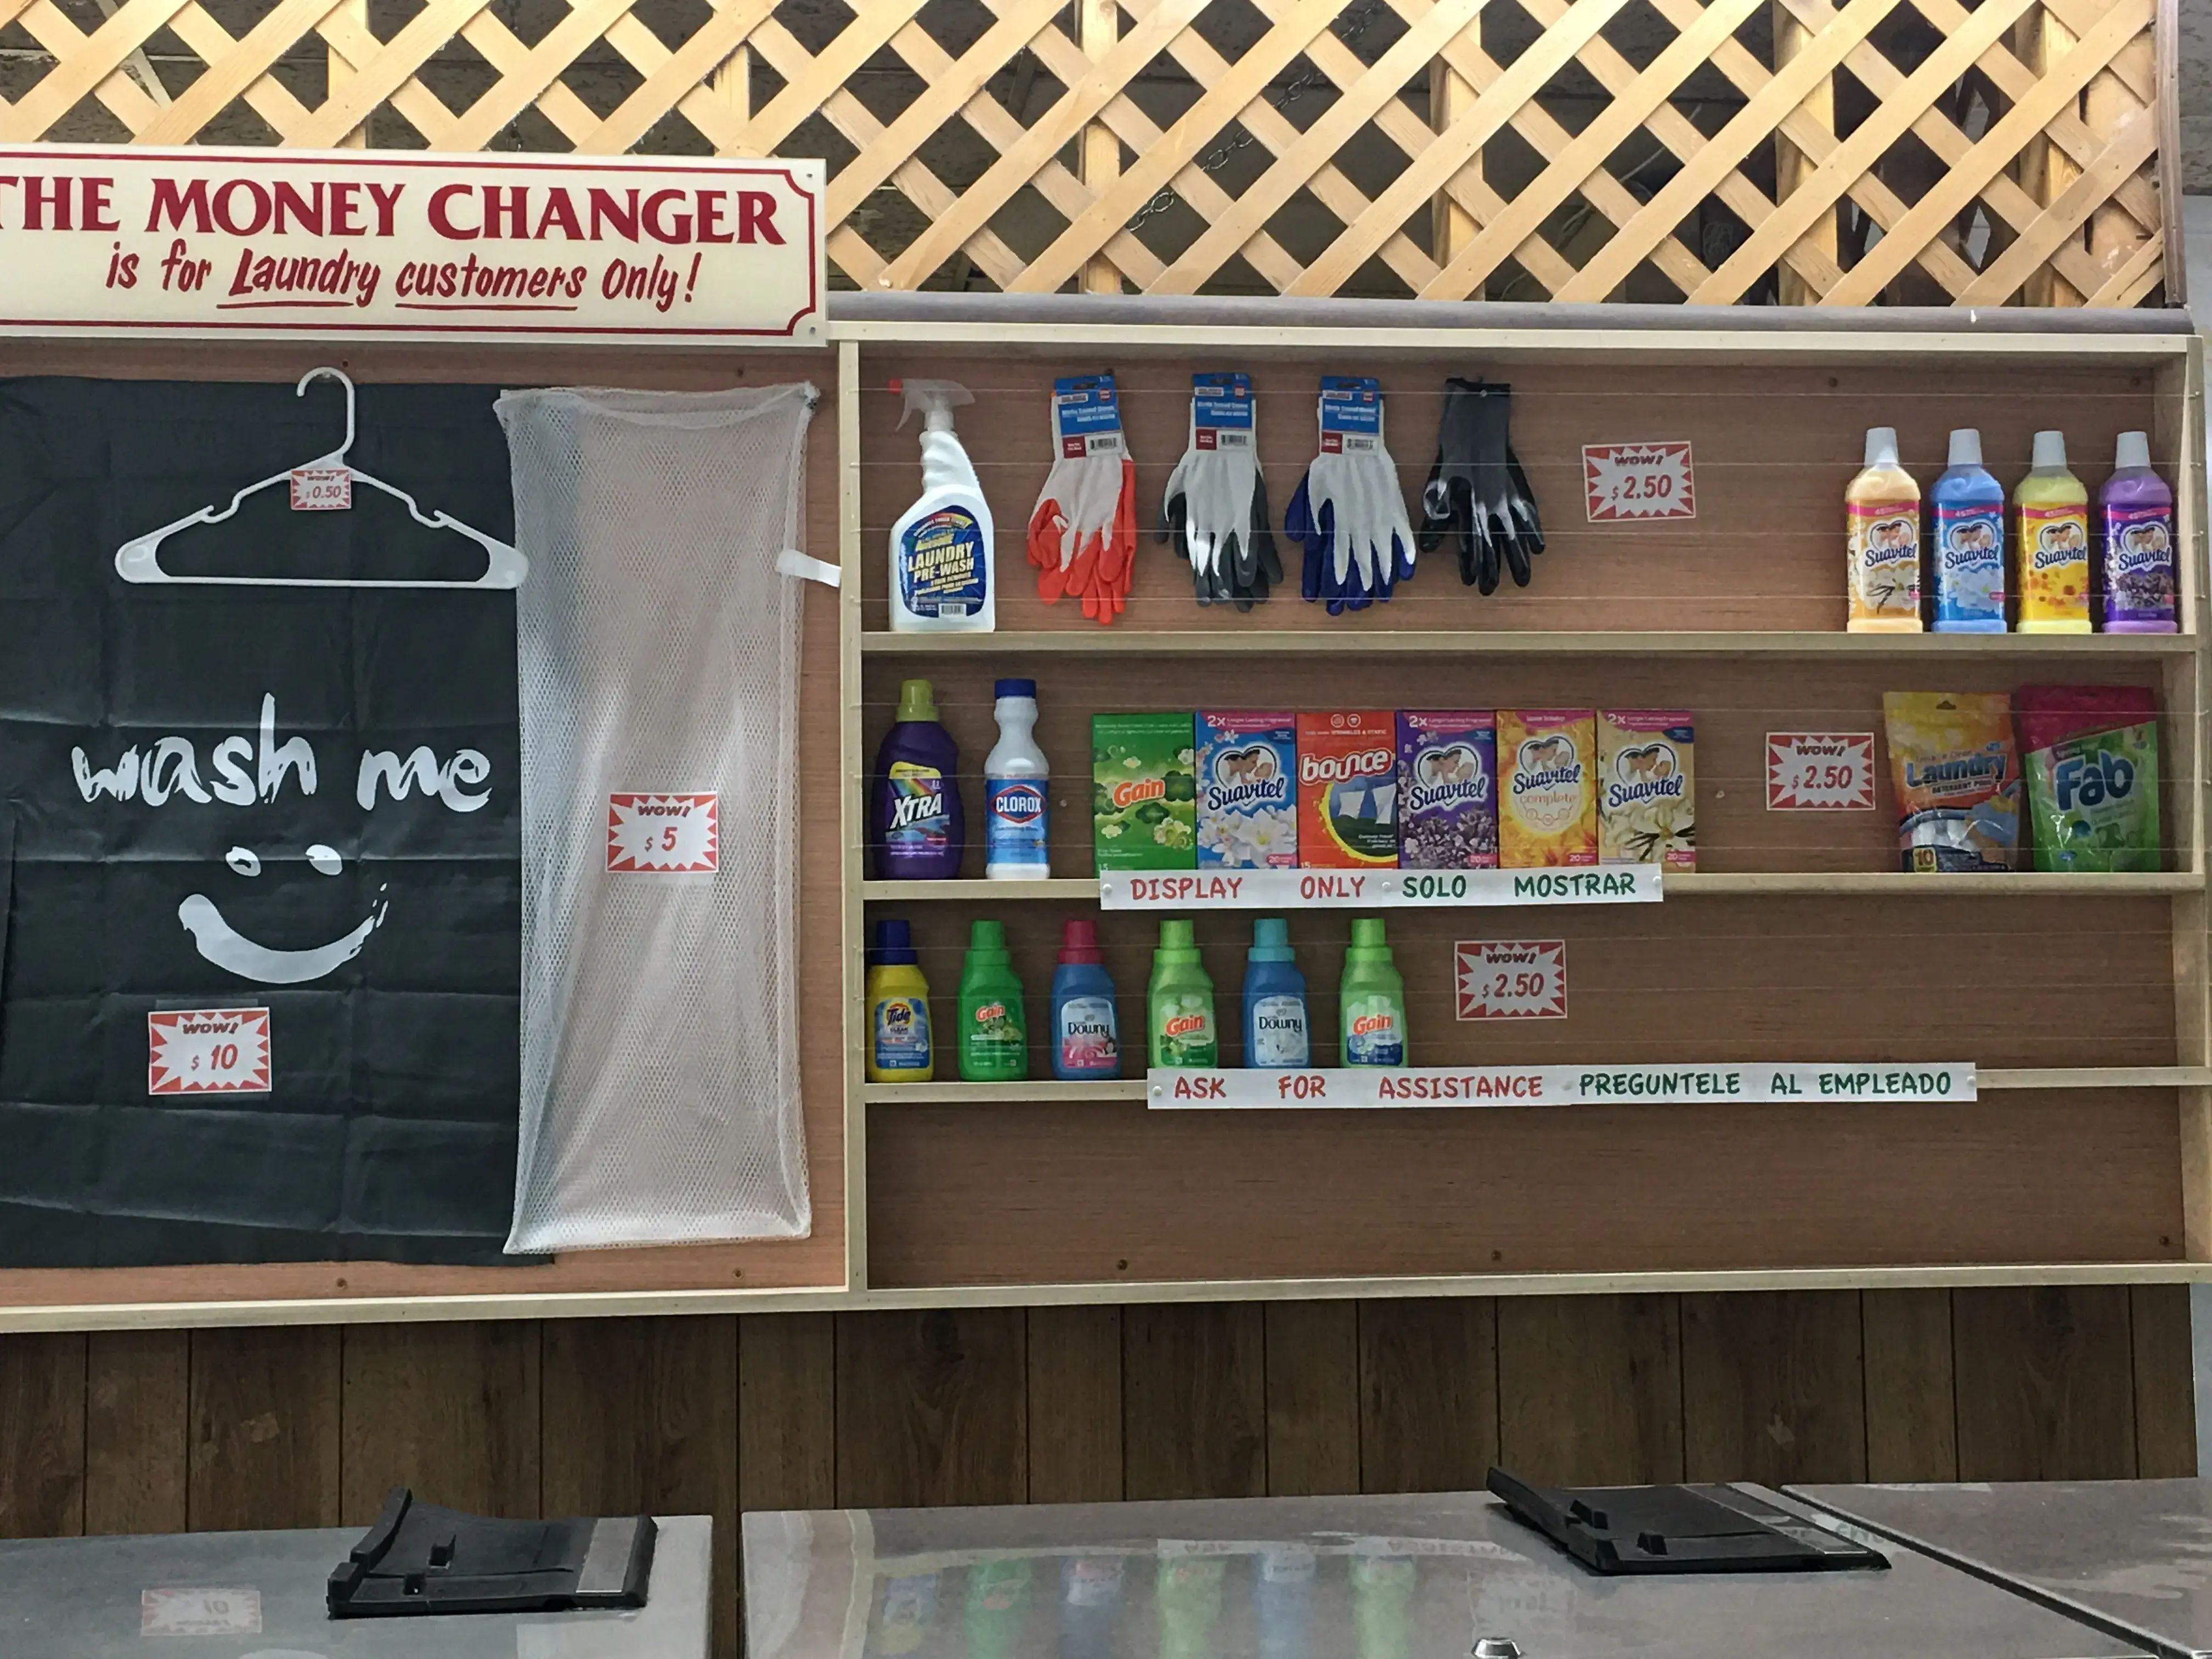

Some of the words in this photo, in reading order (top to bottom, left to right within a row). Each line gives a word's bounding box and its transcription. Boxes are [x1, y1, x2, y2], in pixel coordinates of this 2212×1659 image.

[144, 179, 406, 238] MONEY
[428, 184, 787, 245] CHANGER
[106, 241, 139, 289] is
[161, 239, 212, 292] for
[228, 249, 381, 308] Laundry
[396, 253, 587, 300] customers
[601, 252, 702, 313] Only!
[908, 541, 974, 572] LAUNDRY
[1865, 543, 1917, 567] Suavitel
[1945, 545, 1999, 569] Suavitel
[2034, 546, 2087, 569] Suavitel
[2118, 547, 2170, 571] Suavitel
[913, 557, 974, 583] PRE-WASH
[71, 692, 318, 807] wash
[356, 745, 493, 812] me
[1796, 745, 1847, 757] WOW!
[1302, 749, 1390, 781] bounce
[1906, 752, 2006, 788] Laundry
[1513, 764, 1581, 794] Suavitel
[1608, 775, 1684, 808] Suavitel
[2056, 751, 2135, 811] Fab
[996, 797, 1042, 813] CLOROX
[1114, 778, 1166, 808] Gain
[1208, 777, 1285, 811] Suavitel
[1410, 777, 1486, 810] Suavitel
[637, 805, 691, 817] WOW!
[889, 793, 943, 829] XTRA
[1130, 877, 1243, 900] DISPLAY
[1300, 876, 1365, 899] ONLY
[1402, 875, 1467, 898] SOLO
[1514, 872, 1637, 898] MOSTRAR
[1486, 952, 1537, 964] WOW!
[887, 1008, 911, 1026] Tide
[976, 1006, 1006, 1022] Gain
[1165, 1015, 1205, 1036] Gain
[1259, 1016, 1302, 1033] Downy
[1353, 1014, 1393, 1035] Gain
[183, 1022, 239, 1035] WOW!
[1068, 1022, 1110, 1038] Downy
[1174, 1075, 1227, 1099] ASK
[1278, 1075, 1327, 1099] FOR
[1378, 1075, 1543, 1099] ASSISTANCE
[1579, 1072, 1741, 1097] PREGUNTELE
[1770, 1071, 1803, 1096] AL
[1818, 1071, 1951, 1096] EMPLEADO
